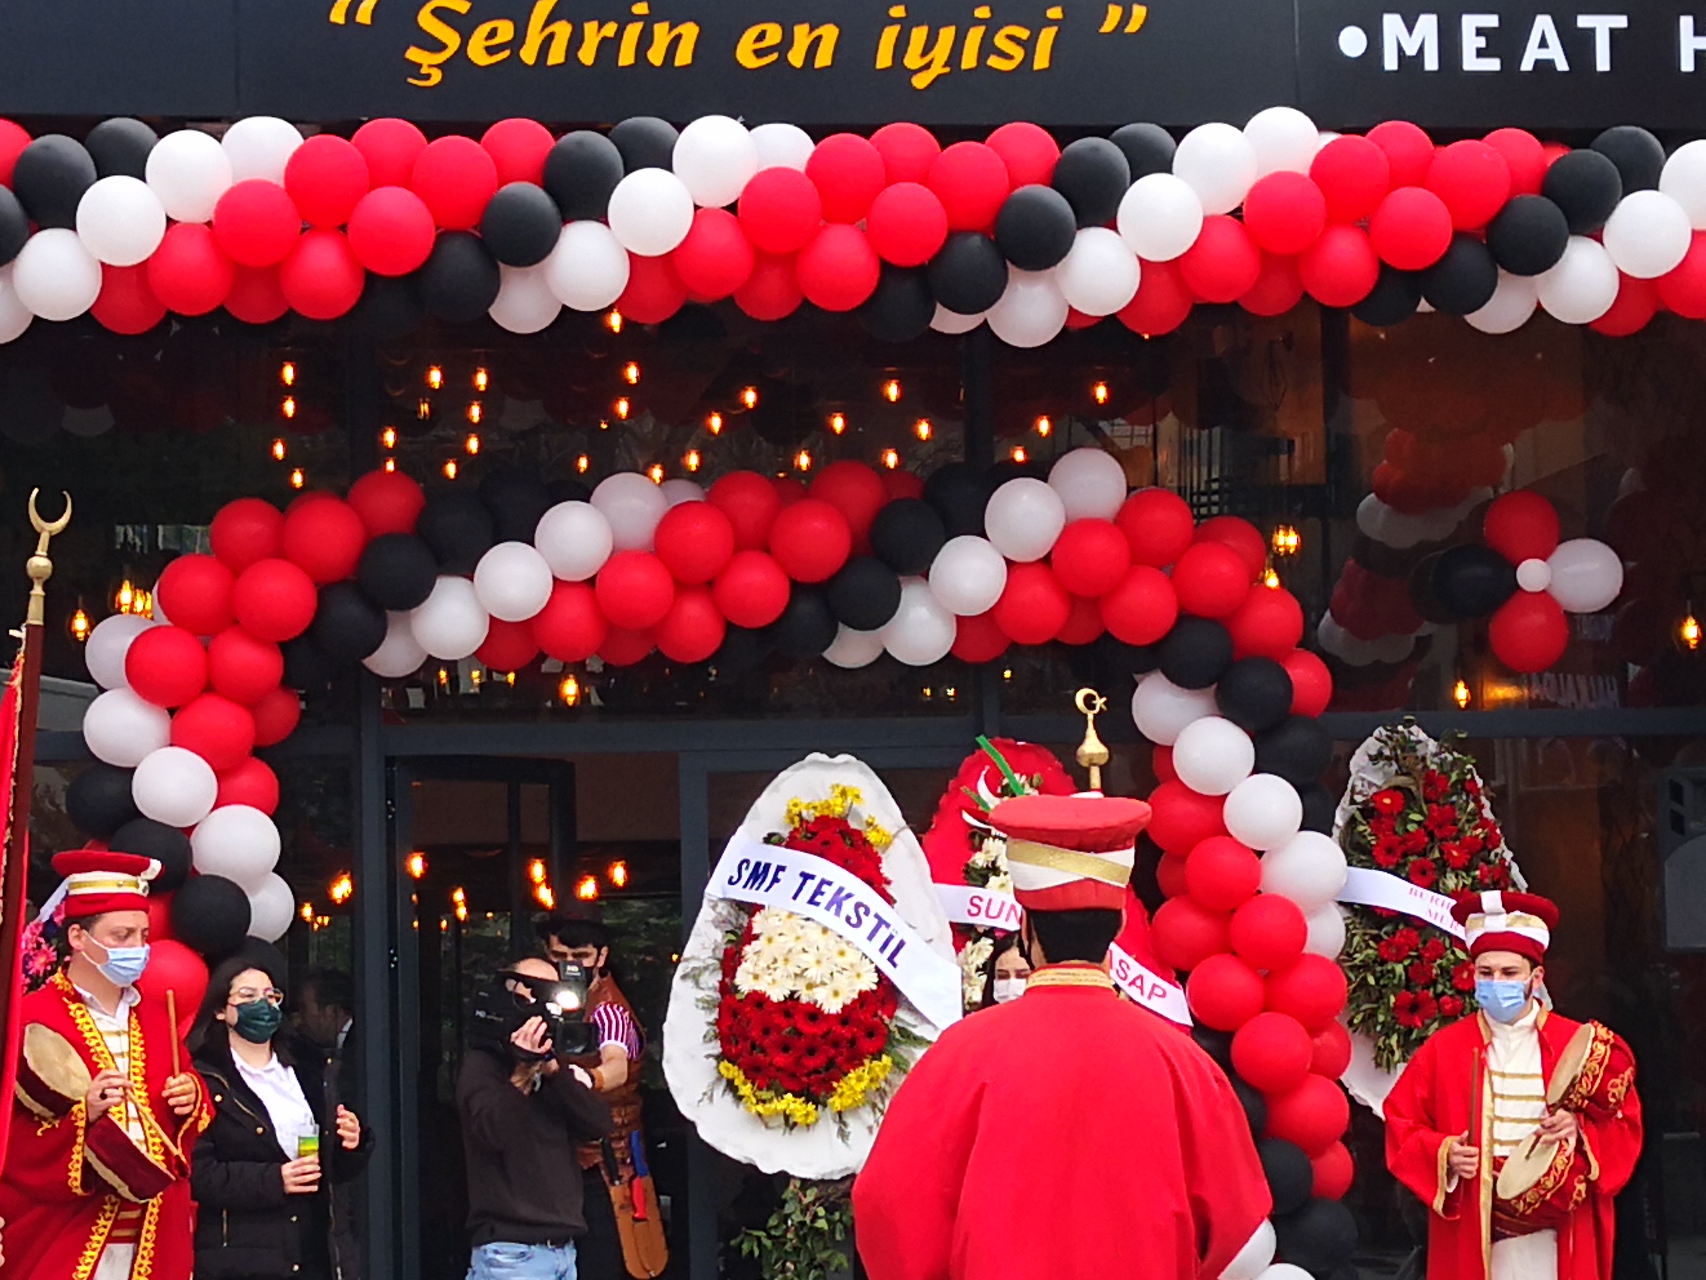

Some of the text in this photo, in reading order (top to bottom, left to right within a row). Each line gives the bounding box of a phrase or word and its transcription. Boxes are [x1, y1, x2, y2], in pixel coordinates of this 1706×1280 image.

[735, 12, 841, 71] en
[874, 3, 1065, 91] iyisi
[1381, 12, 1629, 73] MEAT
[726, 857, 788, 893] SMF
